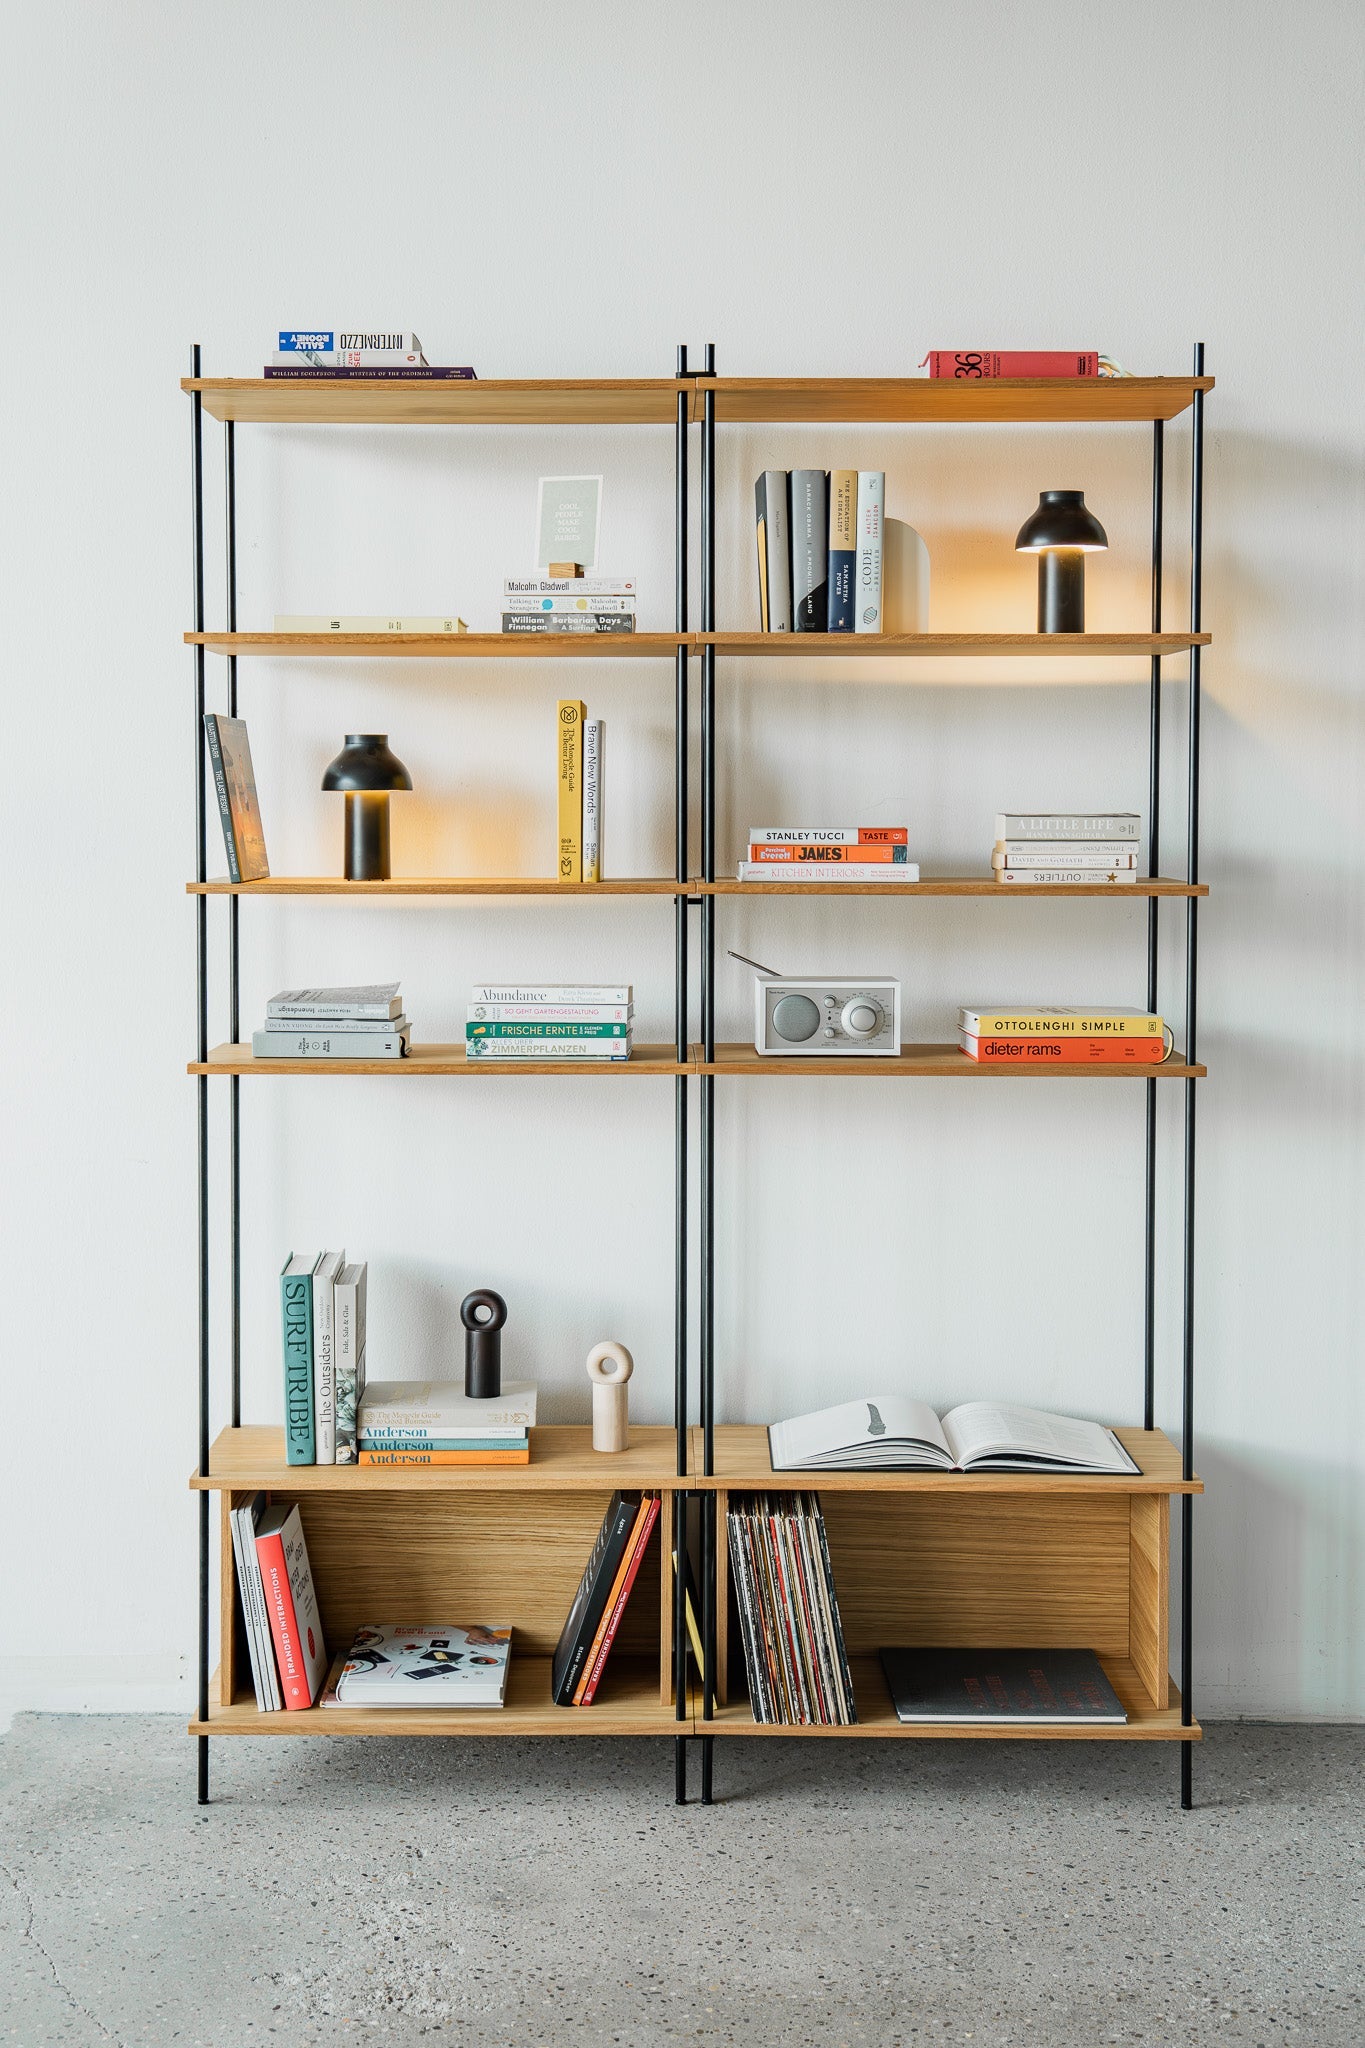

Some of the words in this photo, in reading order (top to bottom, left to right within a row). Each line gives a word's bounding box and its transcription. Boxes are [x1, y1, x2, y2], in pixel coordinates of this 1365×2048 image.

[290, 334, 330, 342] ROONEY
[340, 334, 403, 350] INTERMEZZO
[294, 341, 326, 350] SALLY
[954, 354, 983, 378] 36
[838, 489, 843, 499] AN
[844, 533, 849, 541] OF
[862, 549, 872, 585] CODE
[508, 582, 537, 591] Malcolm
[540, 582, 569, 591] Gladwell
[599, 617, 621, 625] Days
[207, 722, 216, 744] MARTIN
[563, 728, 569, 739] To
[588, 726, 596, 754] Brave
[588, 757, 596, 776] New
[587, 780, 596, 814] Words
[1018, 820, 1026, 829] A
[1031, 820, 1079, 829] LITTLE
[1084, 820, 1114, 829] LIFE
[760, 852, 790, 860] Everett
[798, 847, 842, 860] JAMES
[771, 869, 812, 877] KITCHEN
[815, 868, 864, 877] INTERIORS
[1034, 873, 1081, 882] OUTLIERS
[480, 989, 546, 1001] Abundance
[502, 1026, 542, 1035] FRISCHE
[546, 1026, 578, 1035] ERNTE
[995, 1022, 1074, 1031] OTTOLENGHI
[1082, 1022, 1125, 1031] SIMPLE
[491, 1045, 587, 1053] ZIMMERPFLANZEN
[984, 1042, 1025, 1056] dieter
[1028, 1045, 1061, 1056] rams
[286, 1282, 306, 1354] SURF
[319, 1334, 331, 1397] Outsiders
[288, 1362, 309, 1441] TRIBE
[320, 1401, 331, 1428] The
[364, 1427, 427, 1437] Anderson
[371, 1440, 433, 1450] Anderson
[367, 1454, 431, 1464] Anderson
[270, 1567, 287, 1630] INTERACTIONS
[283, 1632, 295, 1674] BRANDED
[575, 1646, 584, 1662] Bieke
[582, 1644, 599, 1681] GROSSARTIG
[591, 1639, 611, 1682] KRACHMACHER
[565, 1664, 579, 1693] Depoorter
